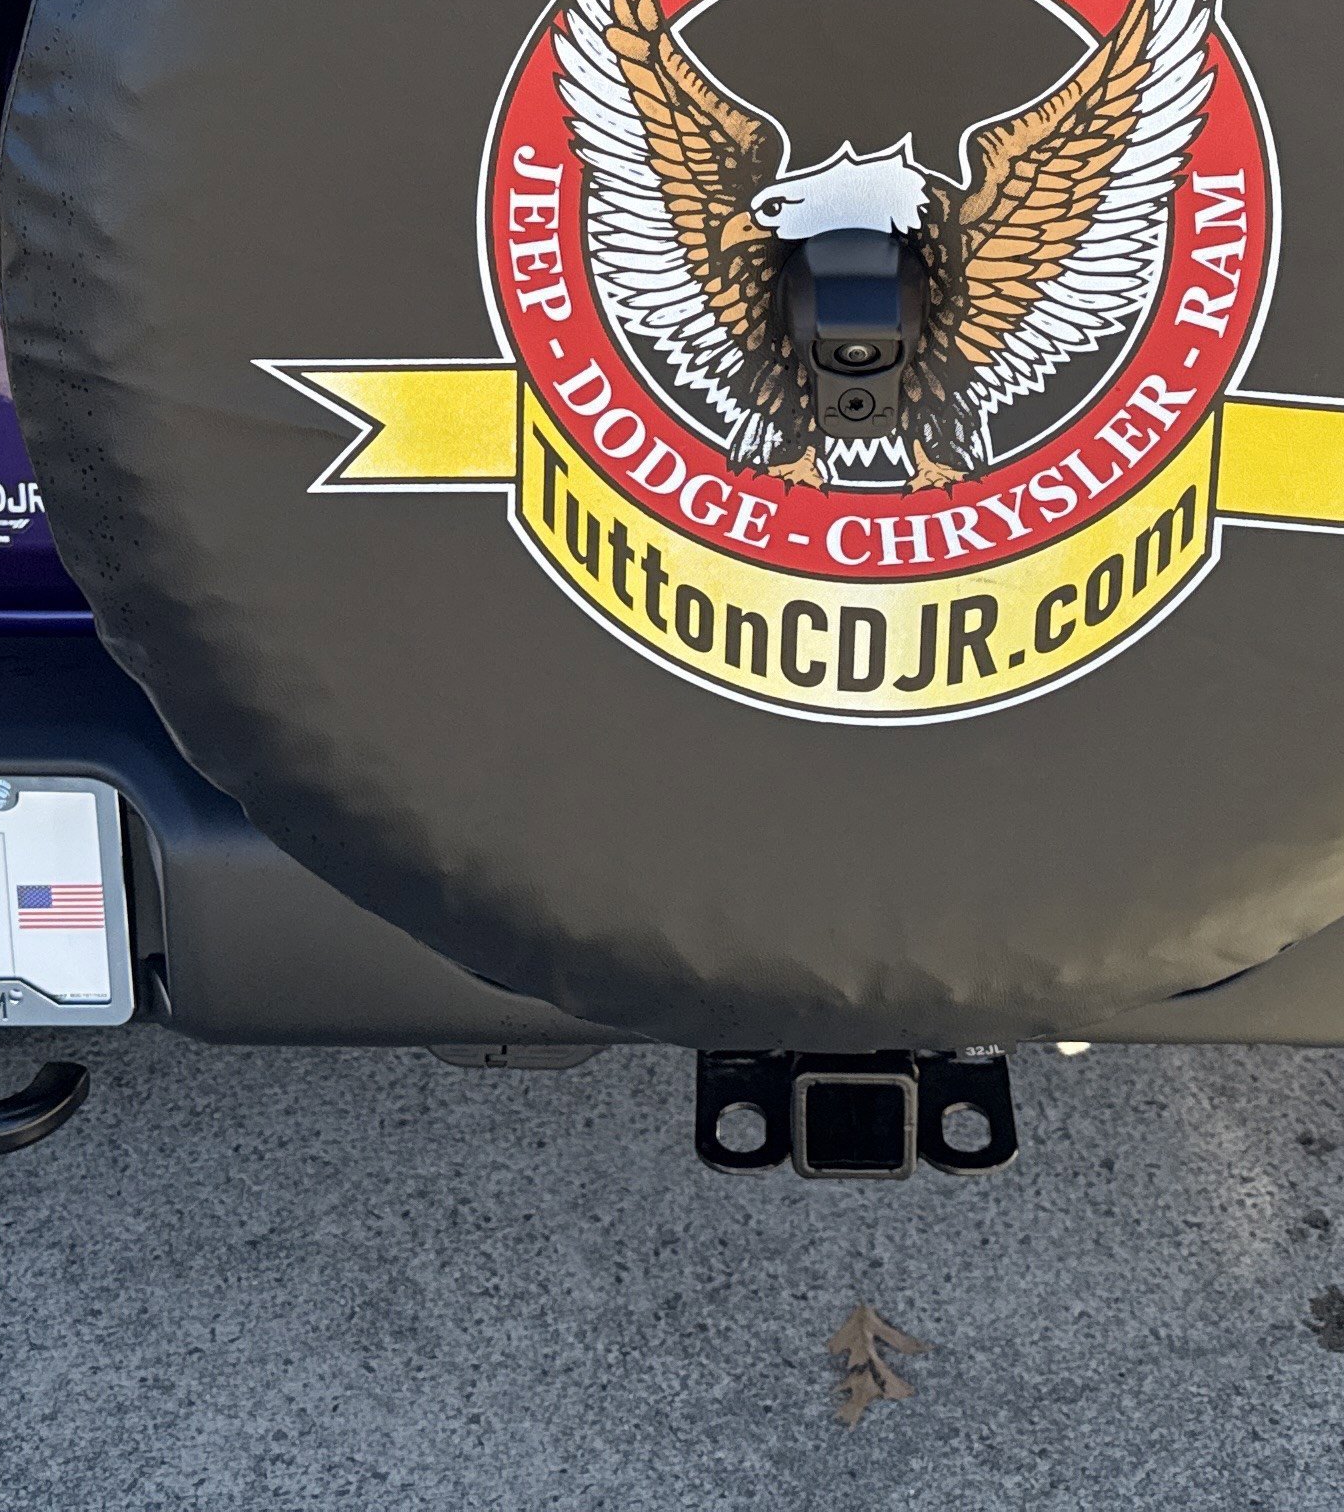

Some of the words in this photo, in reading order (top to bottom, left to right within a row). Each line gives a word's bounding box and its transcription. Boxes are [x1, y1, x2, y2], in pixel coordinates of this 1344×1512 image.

[509, 144, 573, 322] JEEP
[553, 357, 778, 551] DODGE
[825, 373, 1195, 567] CHRYSLER
[1177, 167, 1247, 339] RAM
[531, 429, 1200, 693] TuttonCDJR.com
